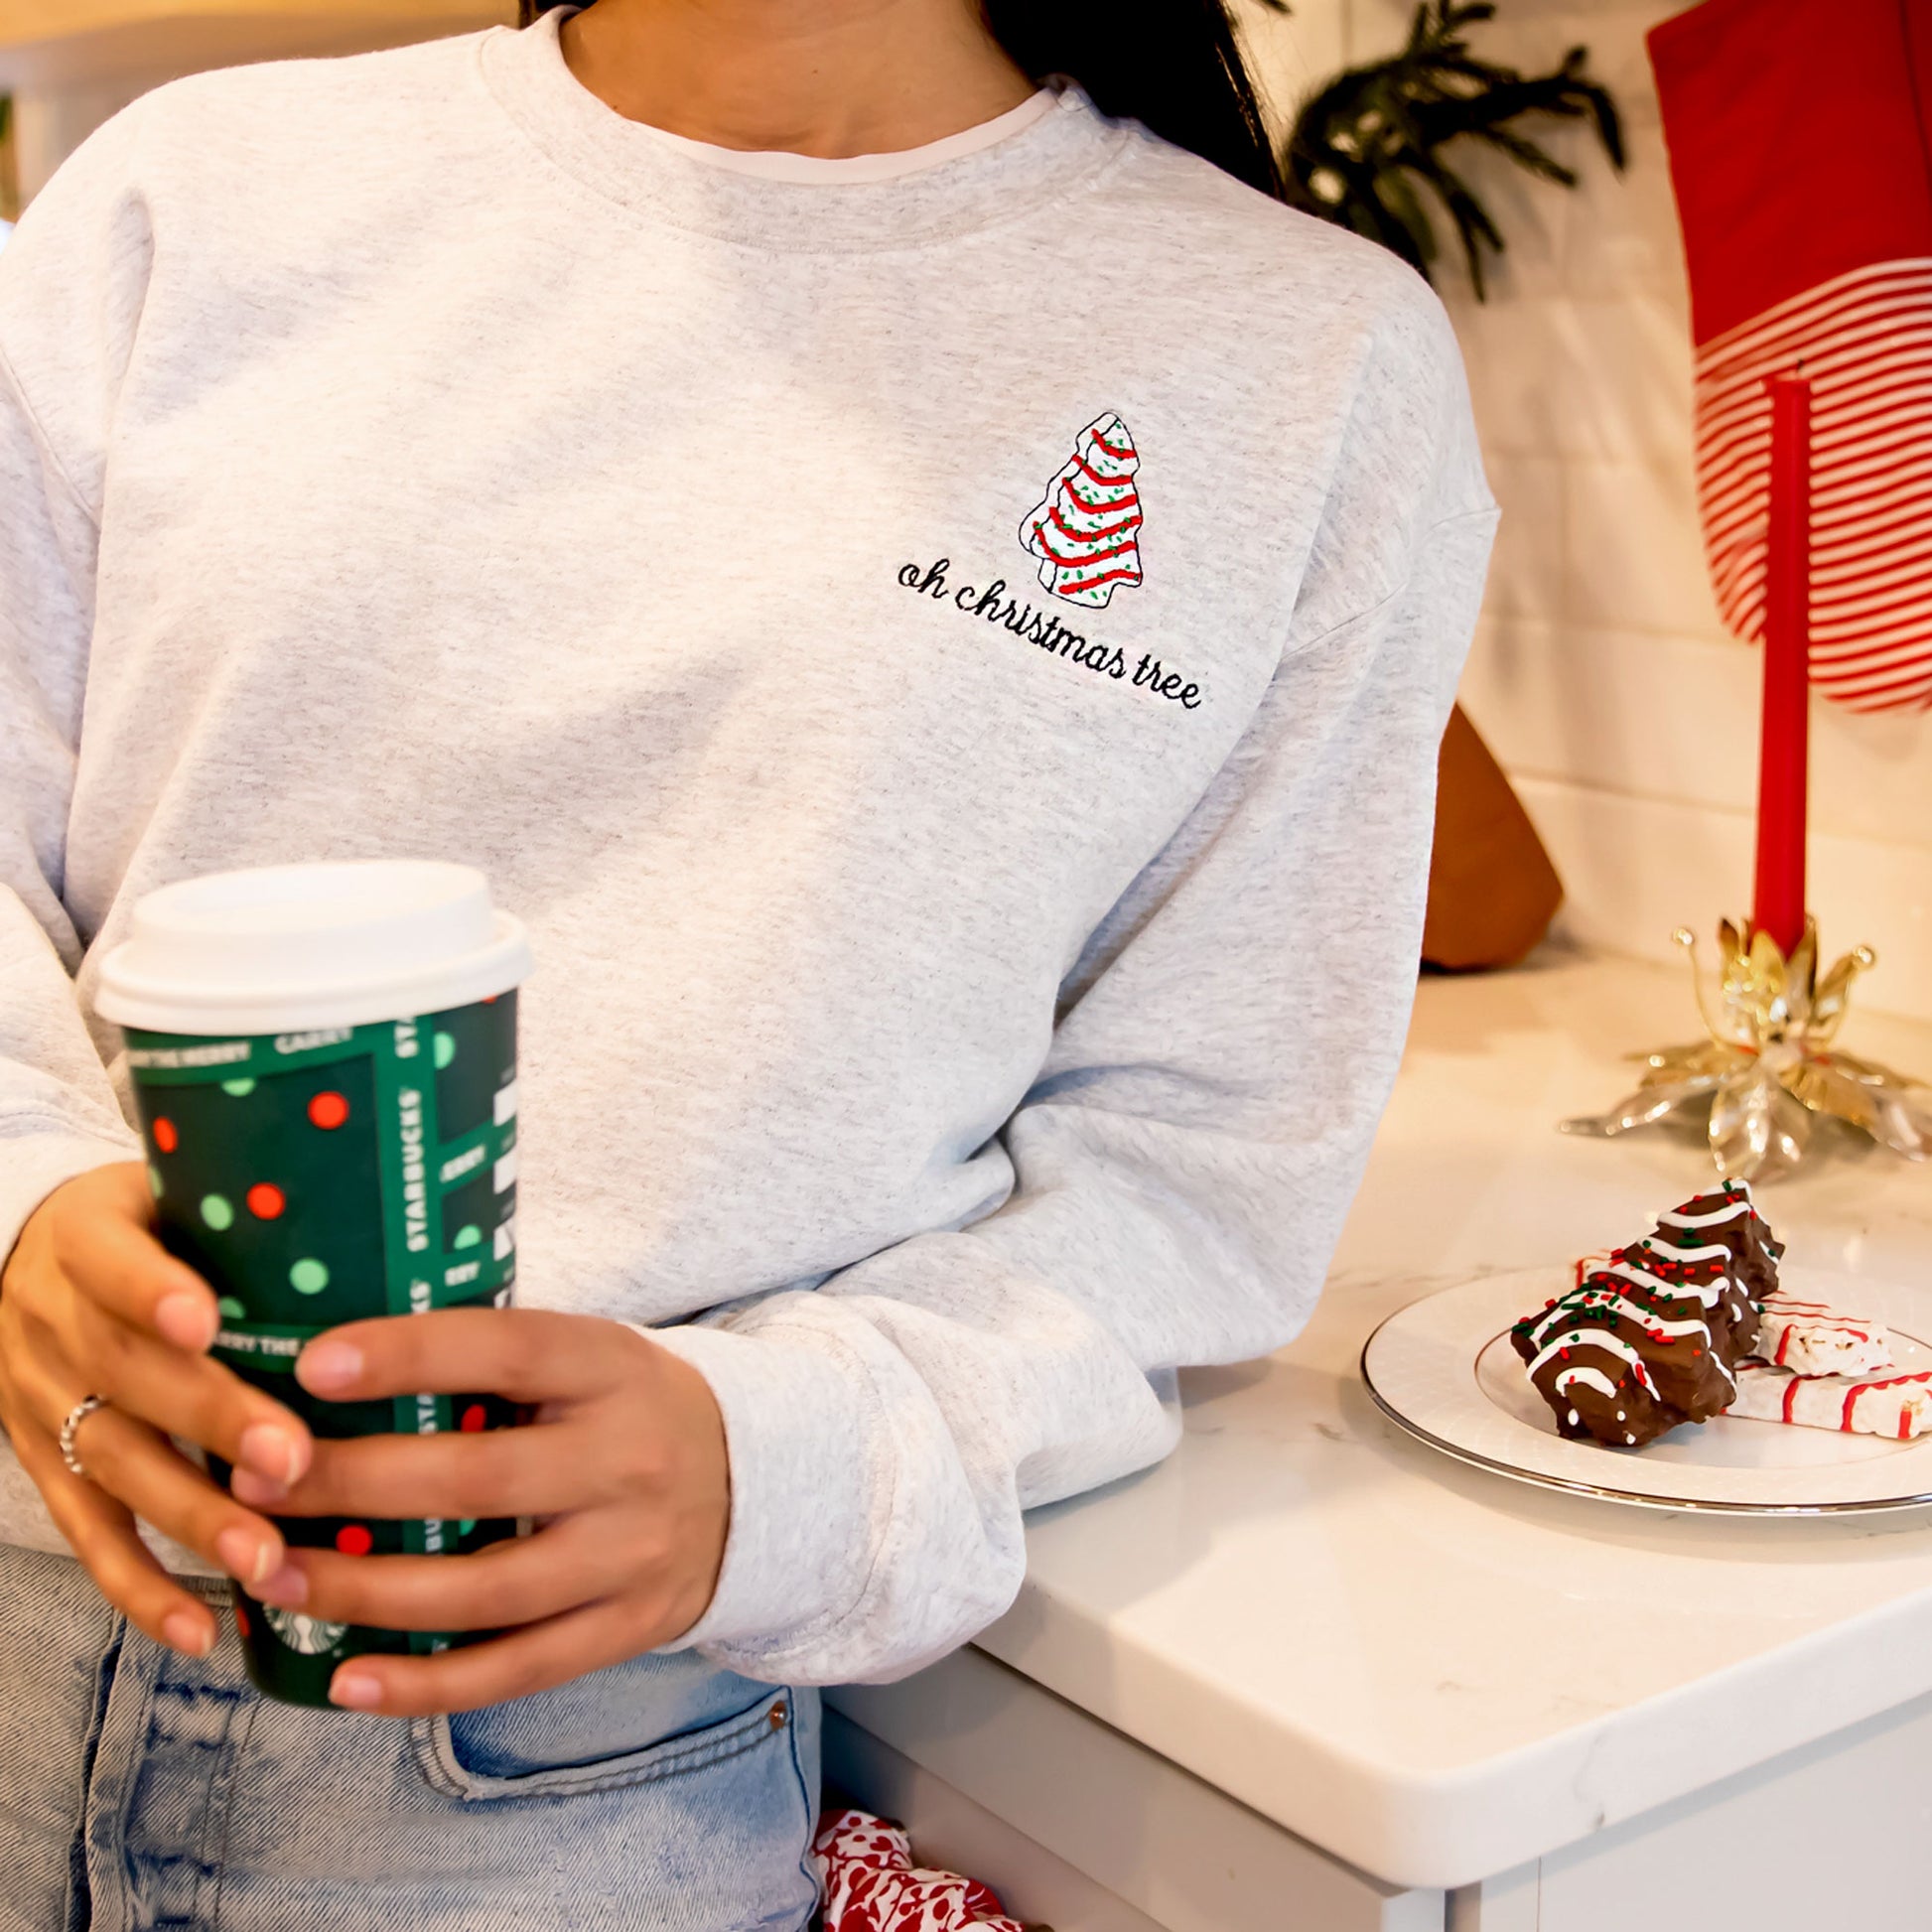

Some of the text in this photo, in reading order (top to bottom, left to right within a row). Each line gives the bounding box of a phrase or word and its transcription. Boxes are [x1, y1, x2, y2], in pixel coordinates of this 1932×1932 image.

[897, 558, 1201, 709] oh christmas tree
[397, 1089, 429, 1252] STARBUCKS
